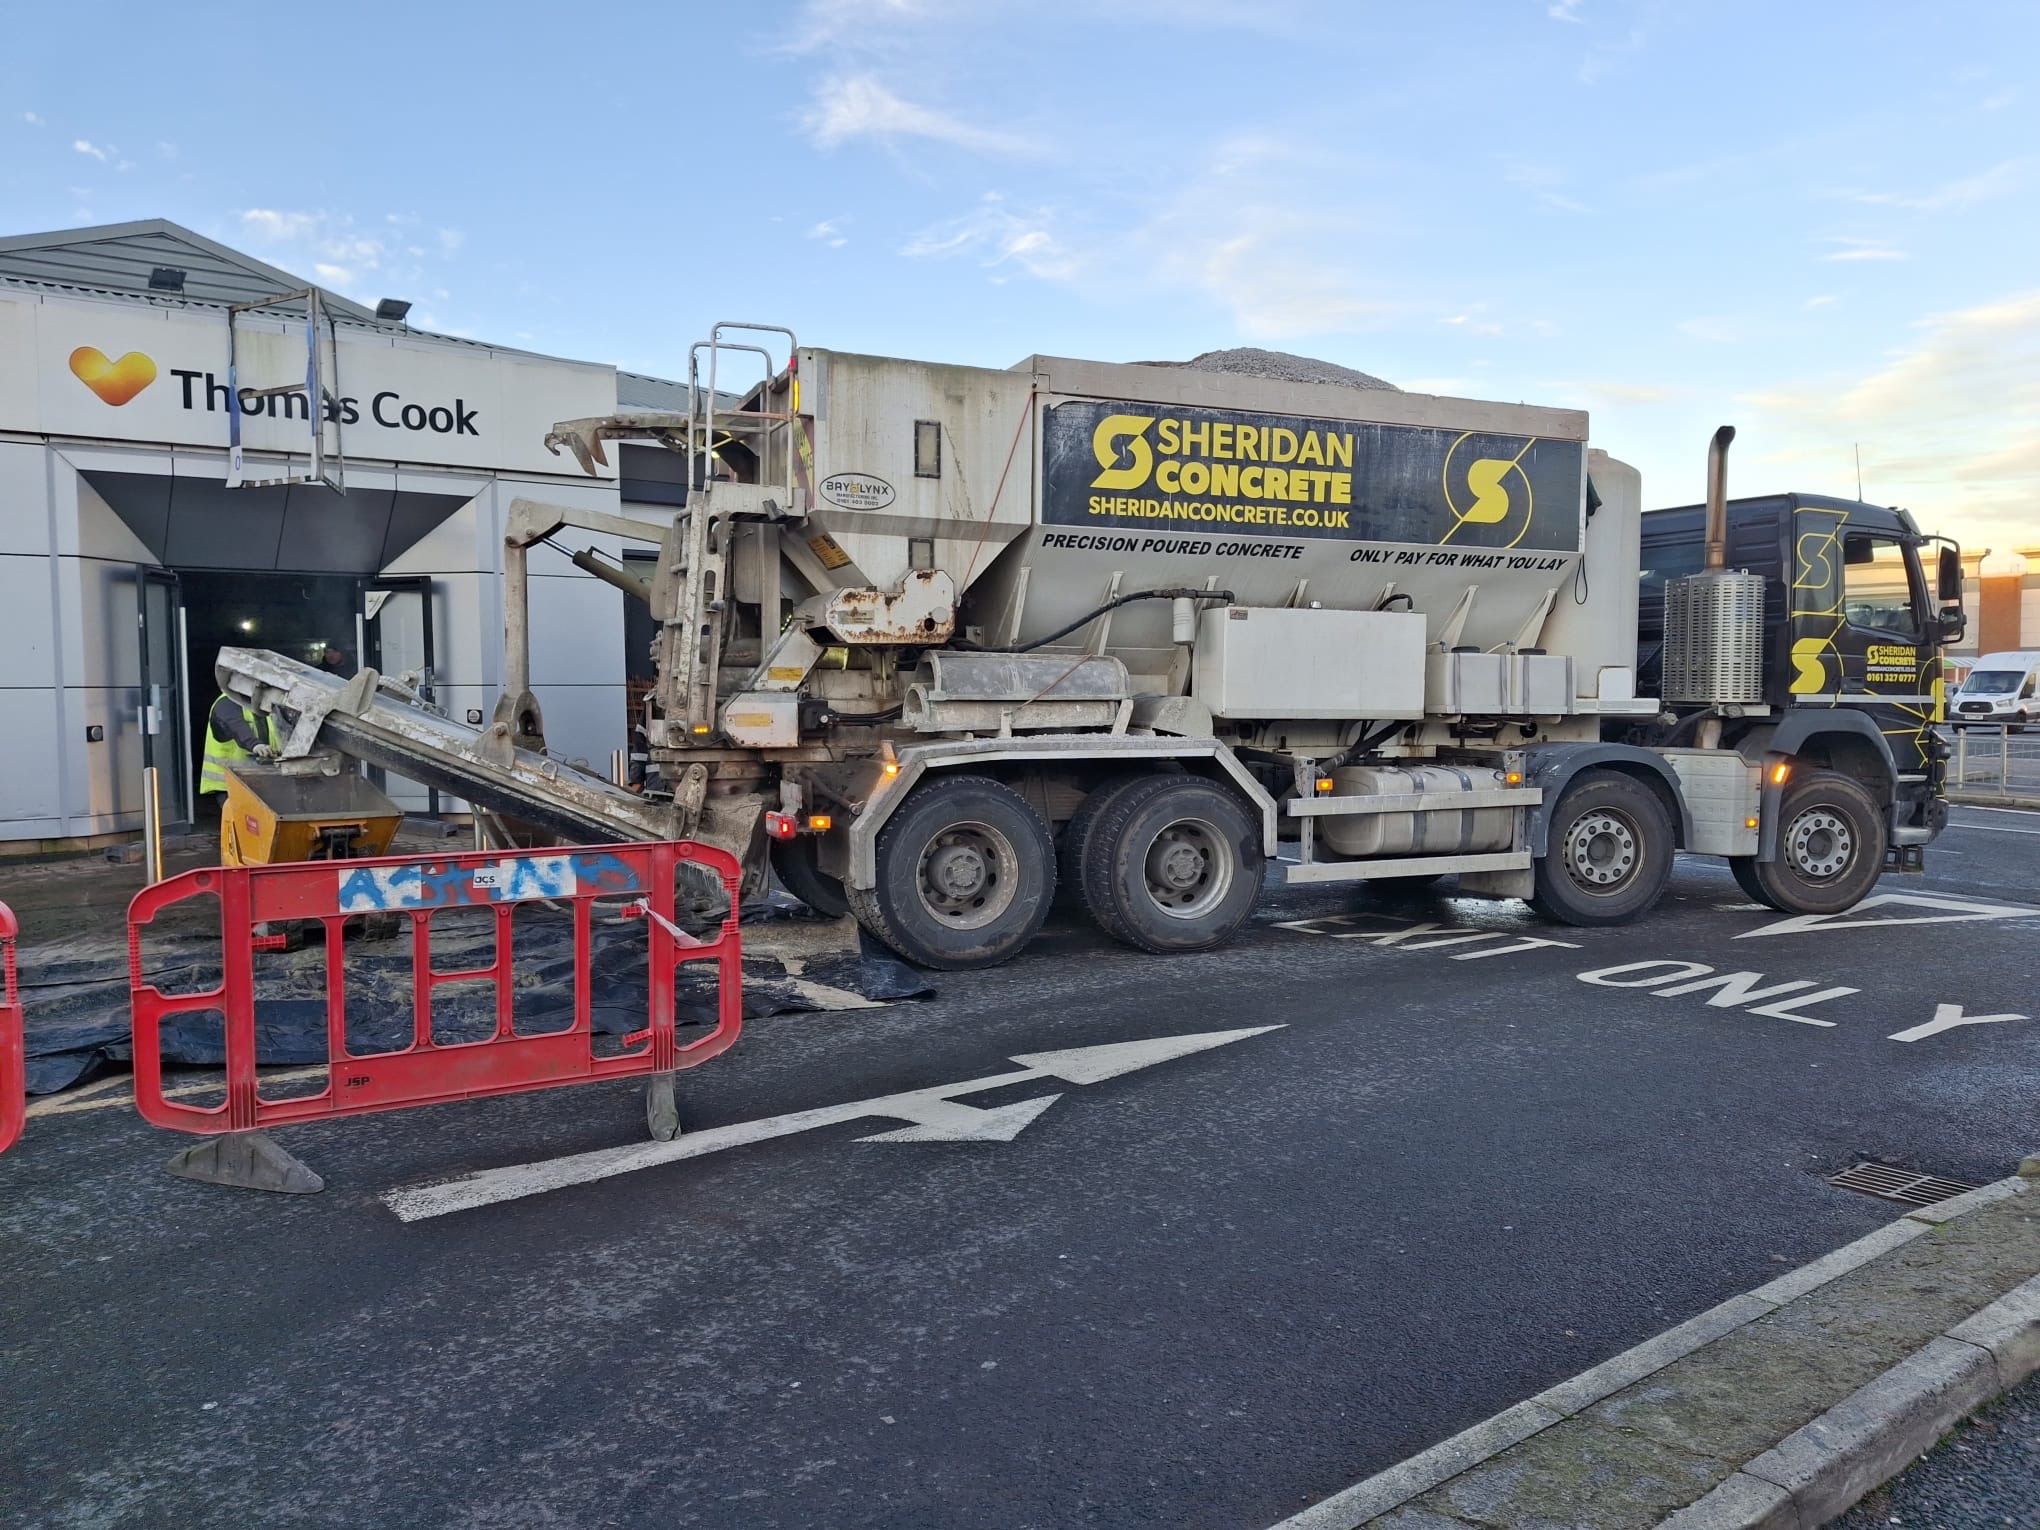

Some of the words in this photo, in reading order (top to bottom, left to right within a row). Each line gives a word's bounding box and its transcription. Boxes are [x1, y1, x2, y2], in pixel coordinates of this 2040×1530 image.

[372, 391, 480, 436] Cook
[1156, 418, 1354, 468] SHERIDAN
[826, 481, 850, 491] BAY
[860, 484, 889, 495] LYNX
[1155, 459, 1352, 504] CONCRETE
[1088, 496, 1350, 529] SHERIDANCONCRETE.CO.UK
[1041, 533, 1139, 552] PRECISION
[1141, 538, 1212, 556] POURED
[1215, 542, 1305, 560] CONCRETE
[1350, 549, 1394, 564] ONLY
[1393, 551, 1424, 565] PAY
[1425, 552, 1459, 566] FOR
[1459, 554, 1505, 569] WHAT
[1506, 556, 1538, 570] YOU
[1536, 558, 1568, 571] LAY
[1879, 645, 1916, 656] SHERIDAN
[1879, 655, 1916, 666] CONCRETE
[1866, 673, 1884, 682] 0161
[1885, 673, 1898, 682] 327
[1899, 673, 1916, 682] 0777
[344, 1076, 370, 1087] JSP
